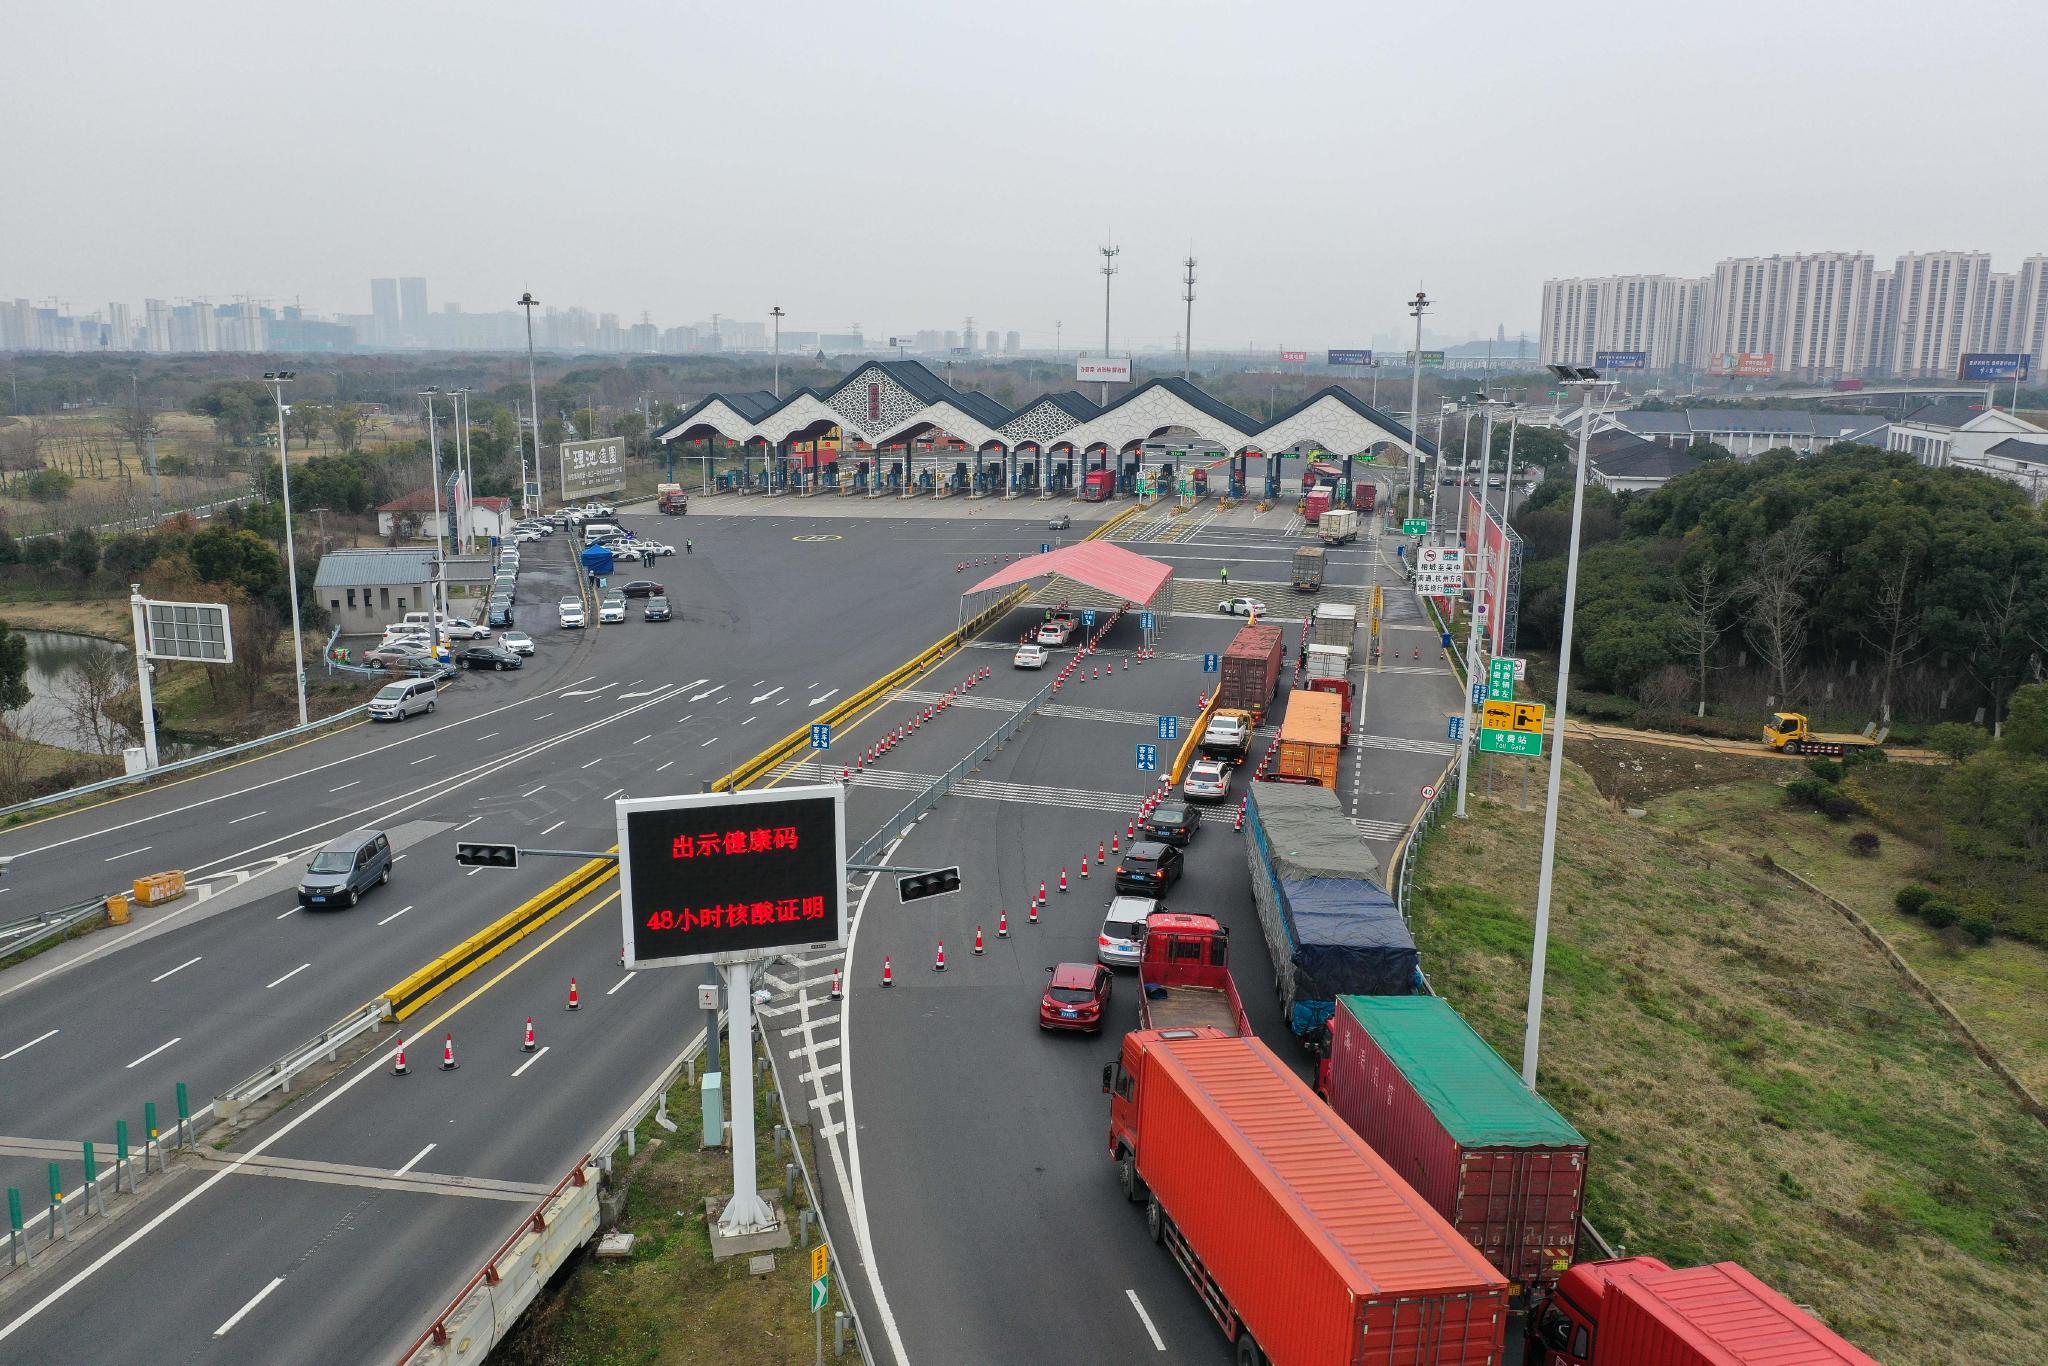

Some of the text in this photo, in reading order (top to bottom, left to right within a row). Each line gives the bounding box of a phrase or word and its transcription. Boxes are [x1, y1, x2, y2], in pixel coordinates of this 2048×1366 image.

[1421, 563, 1461, 572] 相城至吴中
[1494, 662, 1511, 671] 自动
[1492, 671, 1511, 680] 缴费
[1492, 680, 1510, 689] 车辆
[1488, 719, 1506, 727] ETC
[1495, 733, 1527, 745] 收费站
[1510, 743, 1526, 751] Gate
[1138, 746, 1146, 761] 客车
[1147, 746, 1154, 761] 货车
[672, 826, 798, 858] 出示健康码
[646, 895, 825, 932] 48小时核酸证明
